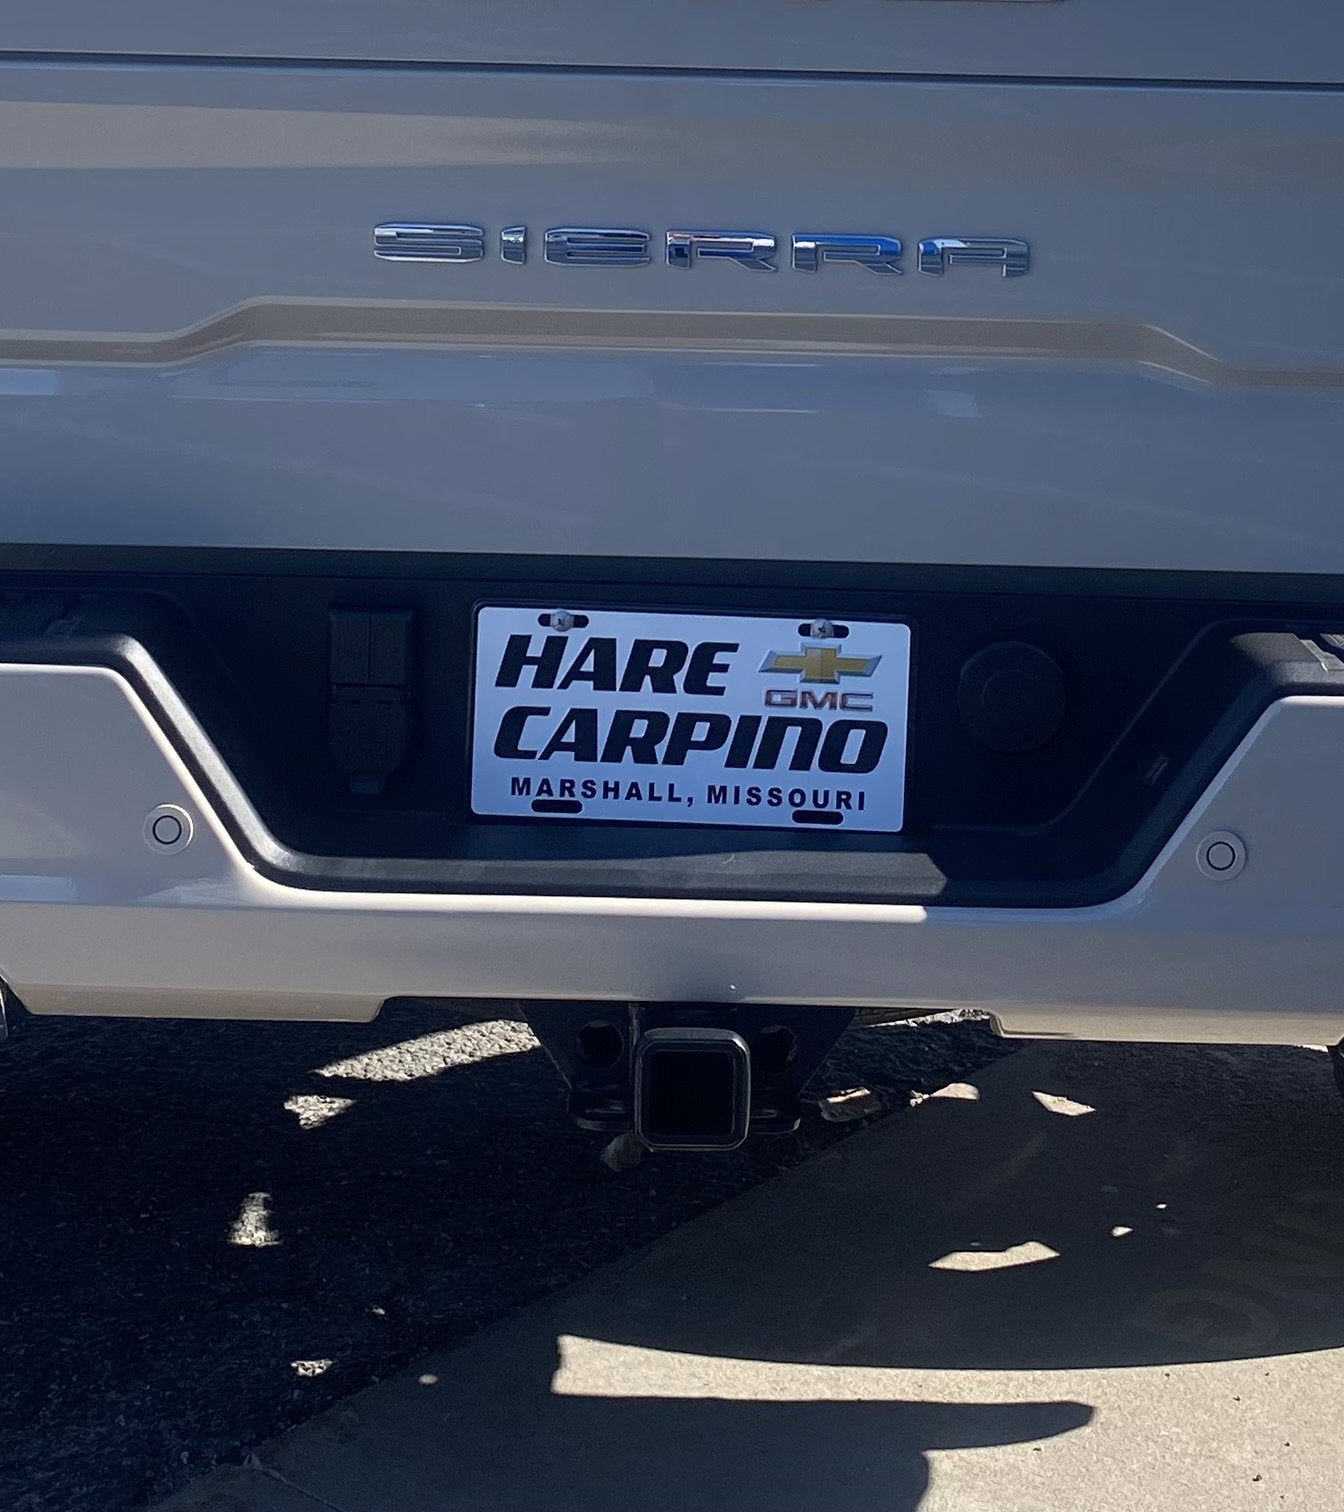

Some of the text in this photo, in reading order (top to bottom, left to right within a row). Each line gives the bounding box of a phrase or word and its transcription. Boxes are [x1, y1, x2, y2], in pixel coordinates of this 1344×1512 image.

[372, 221, 1031, 277] SIERRA
[494, 634, 740, 697] HARE
[763, 688, 874, 713] GMC
[492, 705, 889, 775] CARPINO
[510, 776, 867, 812] MARSHALL, MISSOURI
